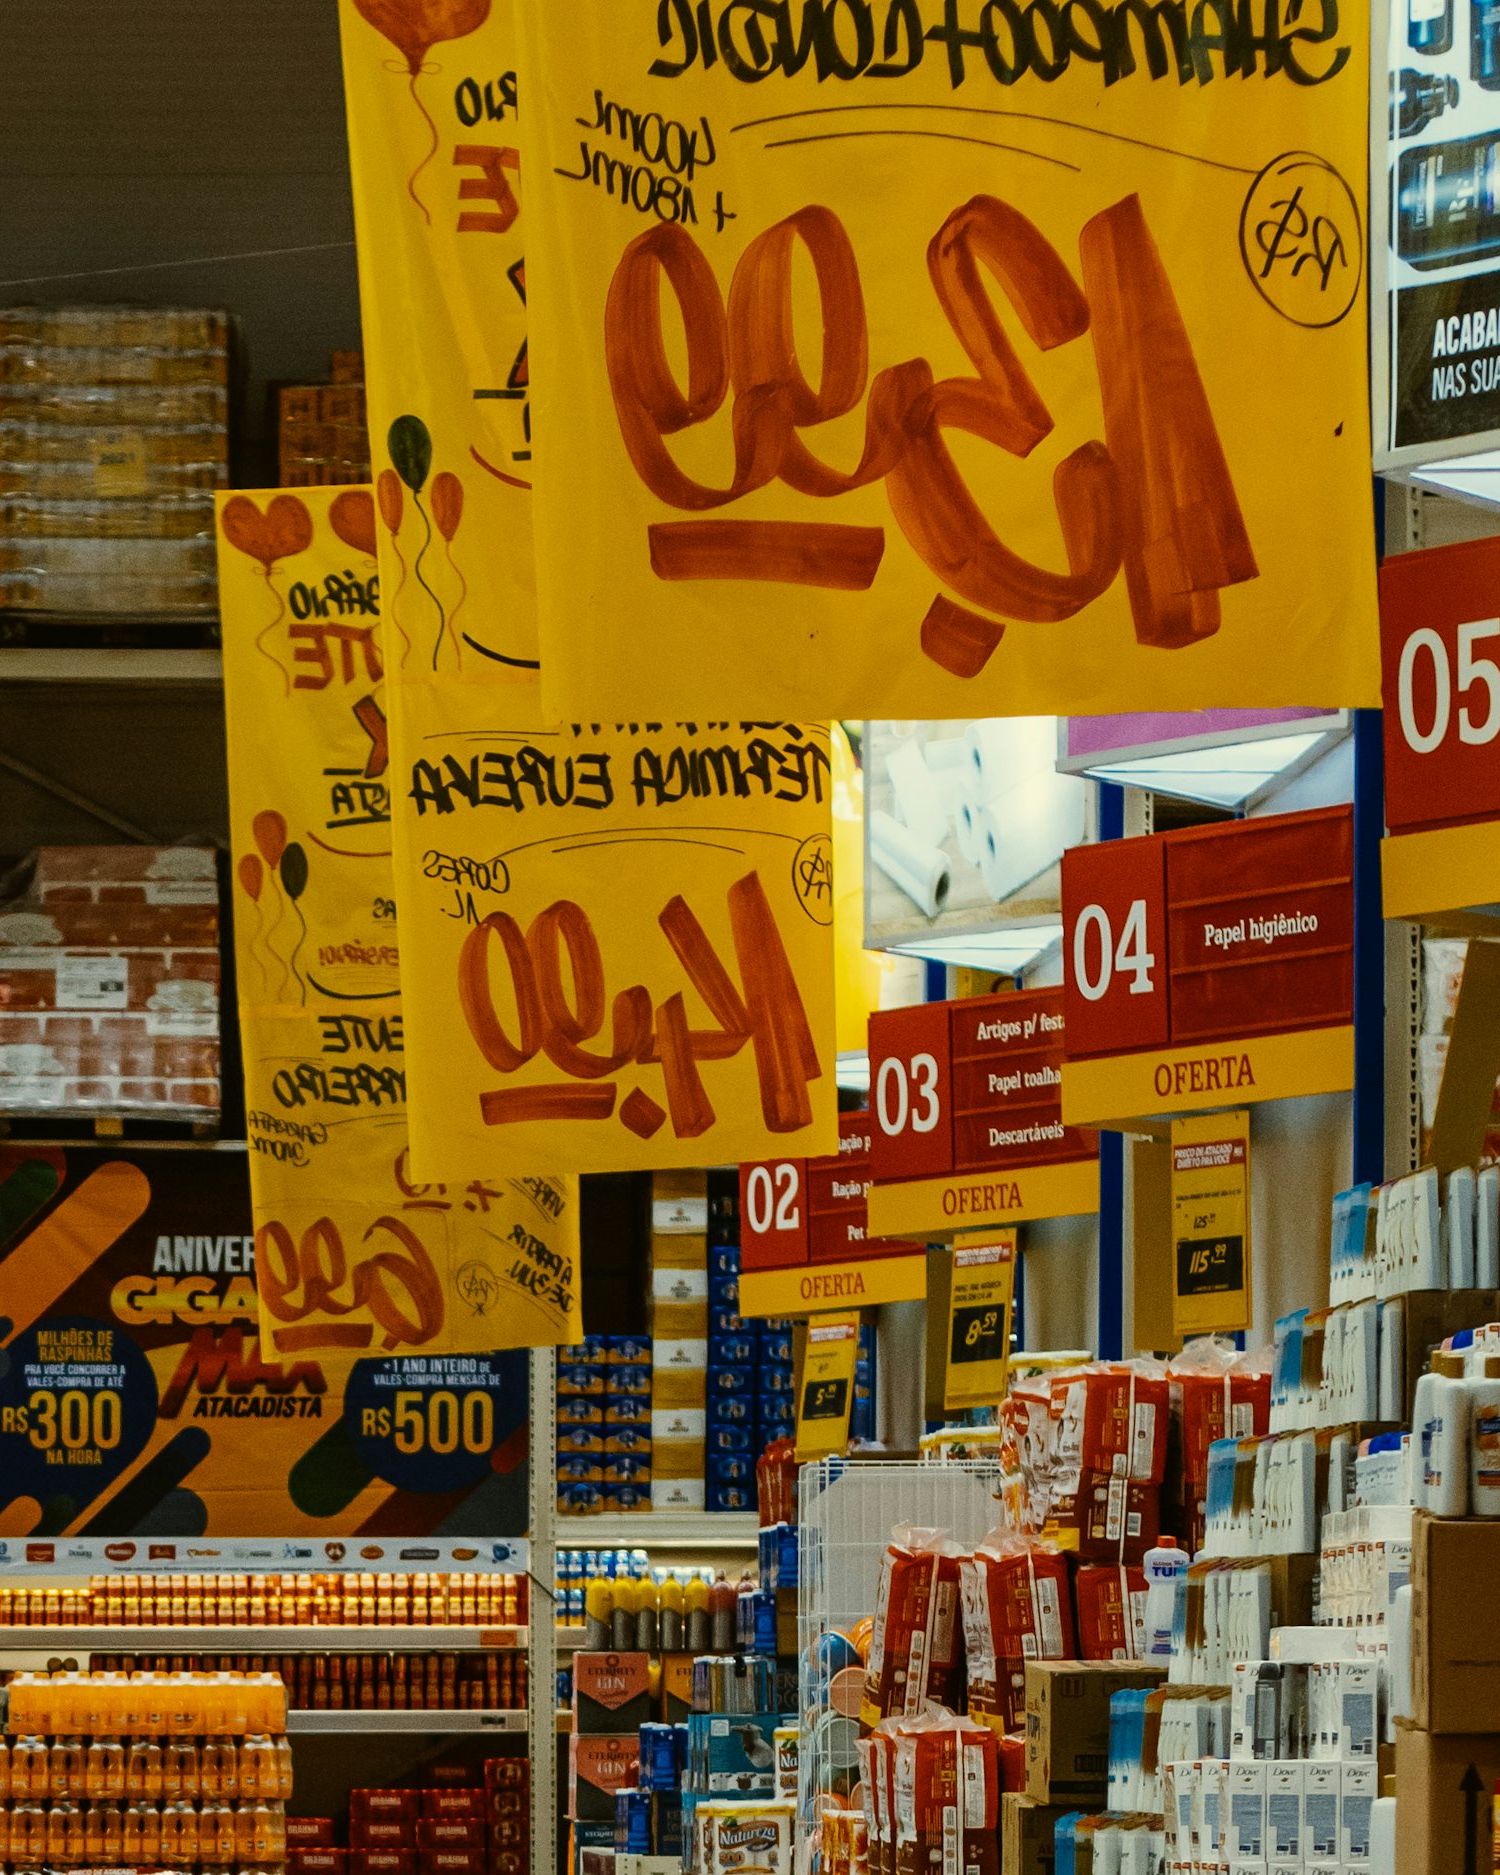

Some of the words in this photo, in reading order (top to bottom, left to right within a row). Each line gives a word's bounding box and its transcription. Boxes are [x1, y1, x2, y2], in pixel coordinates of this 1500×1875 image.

[1431, 361, 1467, 401] NAS
[1398, 617, 1500, 754] 05
[1205, 920, 1246, 947] Papel
[1250, 912, 1318, 942] higiênico
[1073, 900, 1155, 1000] 04
[977, 1018, 1020, 1043] Artigos
[1023, 1017, 1036, 1040] p/
[988, 1070, 1021, 1095] Papel
[1024, 1067, 1061, 1087] toalha
[1155, 1054, 1255, 1097] OFERTA
[876, 1053, 939, 1135] 03
[989, 1122, 1064, 1147] Descartáveis
[747, 1163, 799, 1233] 02
[832, 1181, 861, 1199] Ração
[943, 1182, 1023, 1215] OFERTA
[848, 1225, 863, 1240] Pet
[801, 1273, 865, 1299] OFERTA
[37, 1328, 93, 1345] MILHÕES
[98, 1331, 114, 1345] DE
[40, 1347, 111, 1361] RASPINHAS
[68, 1364, 117, 1375] CONCORRER
[403, 1359, 426, 1372] ANO
[430, 1359, 477, 1373] INTEIRO
[27, 1376, 91, 1387] VALES-COMPRA
[108, 1375, 123, 1387] ATÉ
[373, 1374, 444, 1386] VALES-COMPRA
[446, 1374, 486, 1386] MENSAIS
[193, 1395, 322, 1418] ATACADISTA
[47, 1450, 63, 1464] NA
[68, 1450, 102, 1464] HORA
[1345, 1665, 1373, 1677] Dove
[1236, 1766, 1260, 1777] Dove
[1273, 1766, 1297, 1777] Dove
[719, 1825, 776, 1847] Natureza
